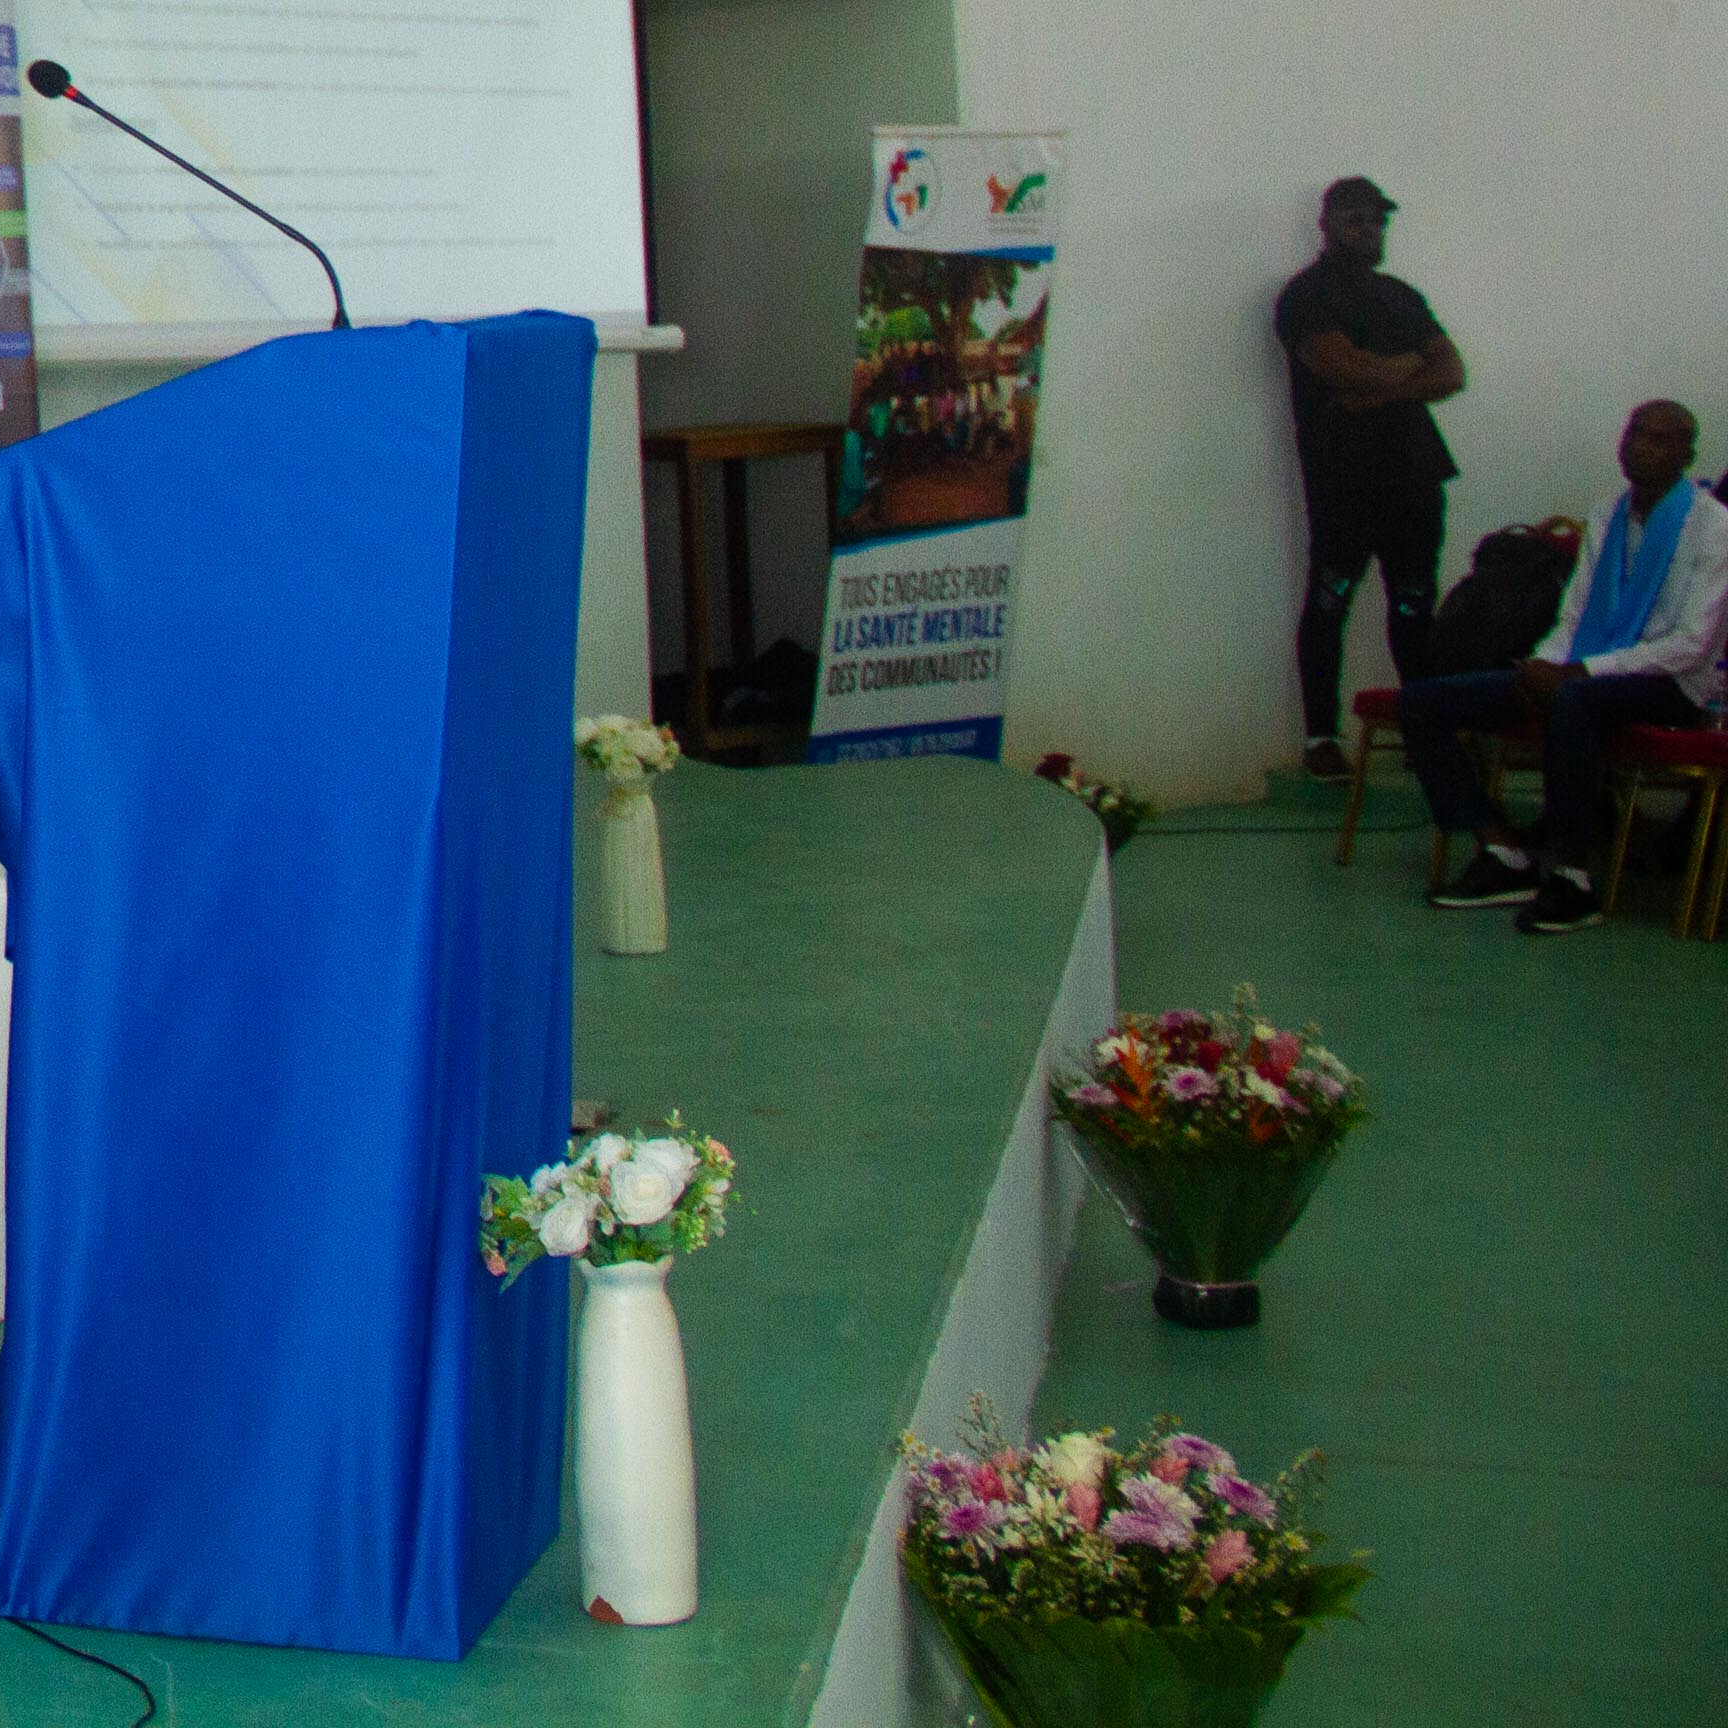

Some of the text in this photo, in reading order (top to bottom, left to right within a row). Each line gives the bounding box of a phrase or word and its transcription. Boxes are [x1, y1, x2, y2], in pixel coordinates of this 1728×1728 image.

[839, 573, 880, 608] TOUS
[832, 603, 1008, 654] LA SANTÉ MENTALE
[827, 660, 858, 696] DES
